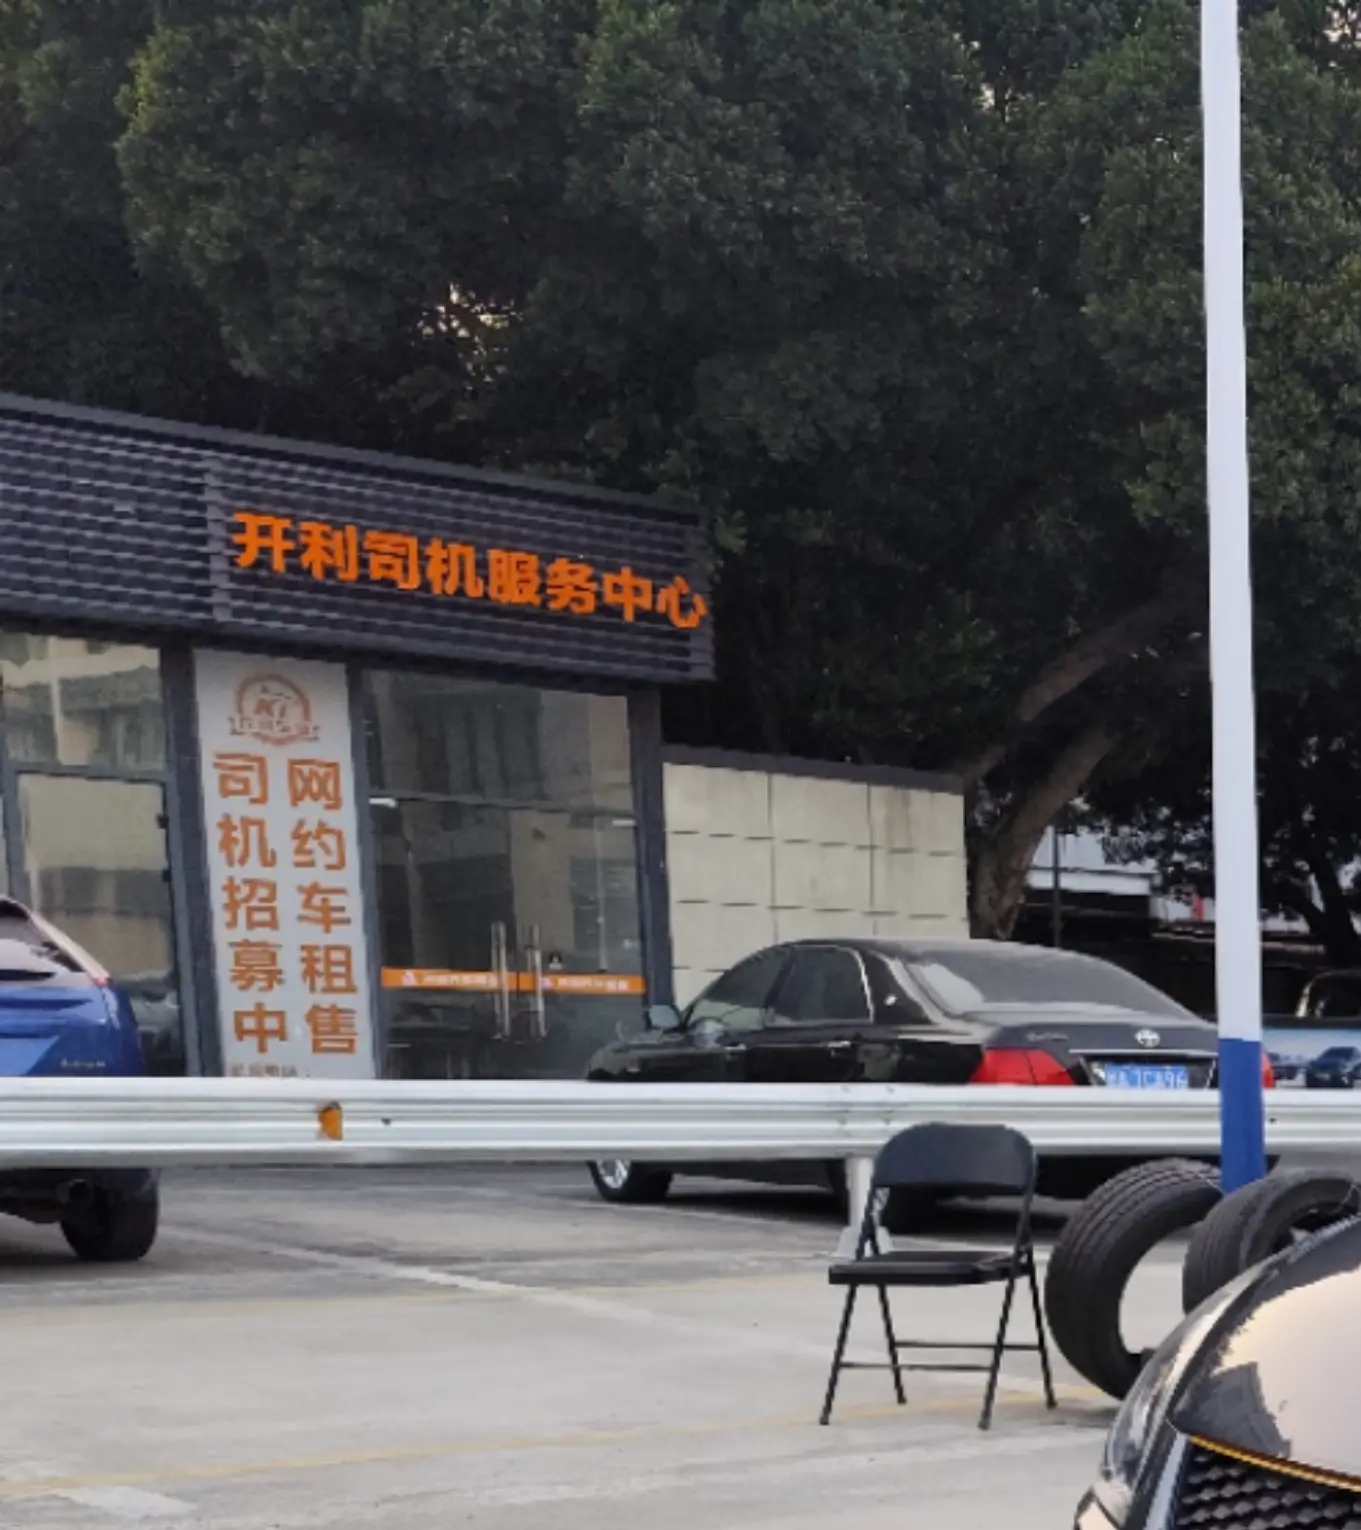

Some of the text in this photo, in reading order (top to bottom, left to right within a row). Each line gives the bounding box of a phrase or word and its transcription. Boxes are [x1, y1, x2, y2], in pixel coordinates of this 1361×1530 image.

[232, 511, 708, 630] 开利司机服务中心
[212, 752, 288, 1054] 司机招募中
[286, 757, 358, 1055] 网约车租售
